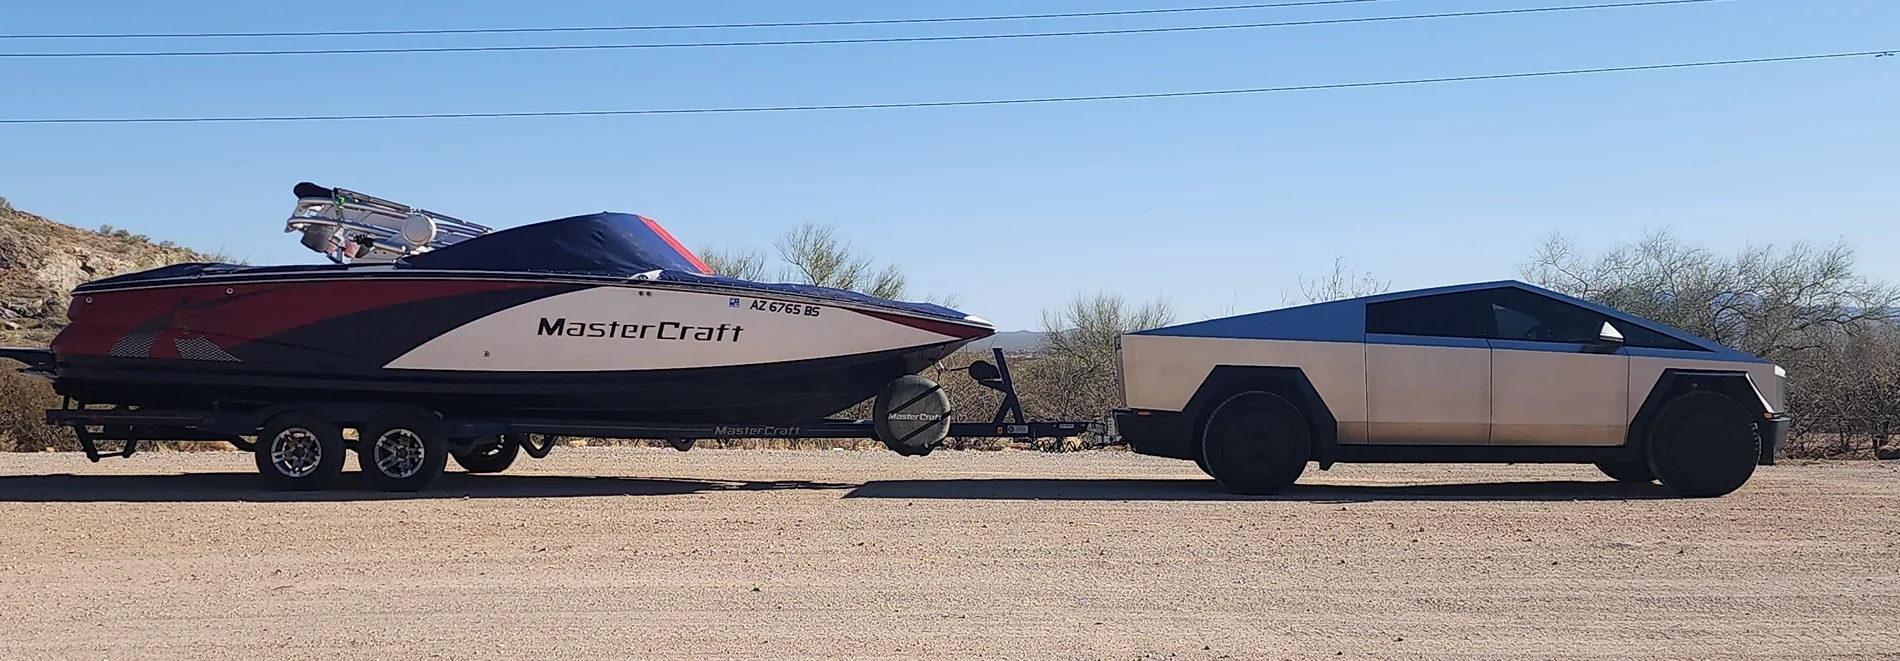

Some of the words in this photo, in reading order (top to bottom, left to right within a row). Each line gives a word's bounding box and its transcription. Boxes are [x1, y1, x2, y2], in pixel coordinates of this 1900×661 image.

[749, 299, 767, 311] AZ
[769, 302, 802, 315] 6765
[803, 305, 820, 317] BS
[537, 317, 743, 342] MasterCraft
[888, 412, 942, 421] MasterCraft
[714, 425, 800, 436] MasterCraft
